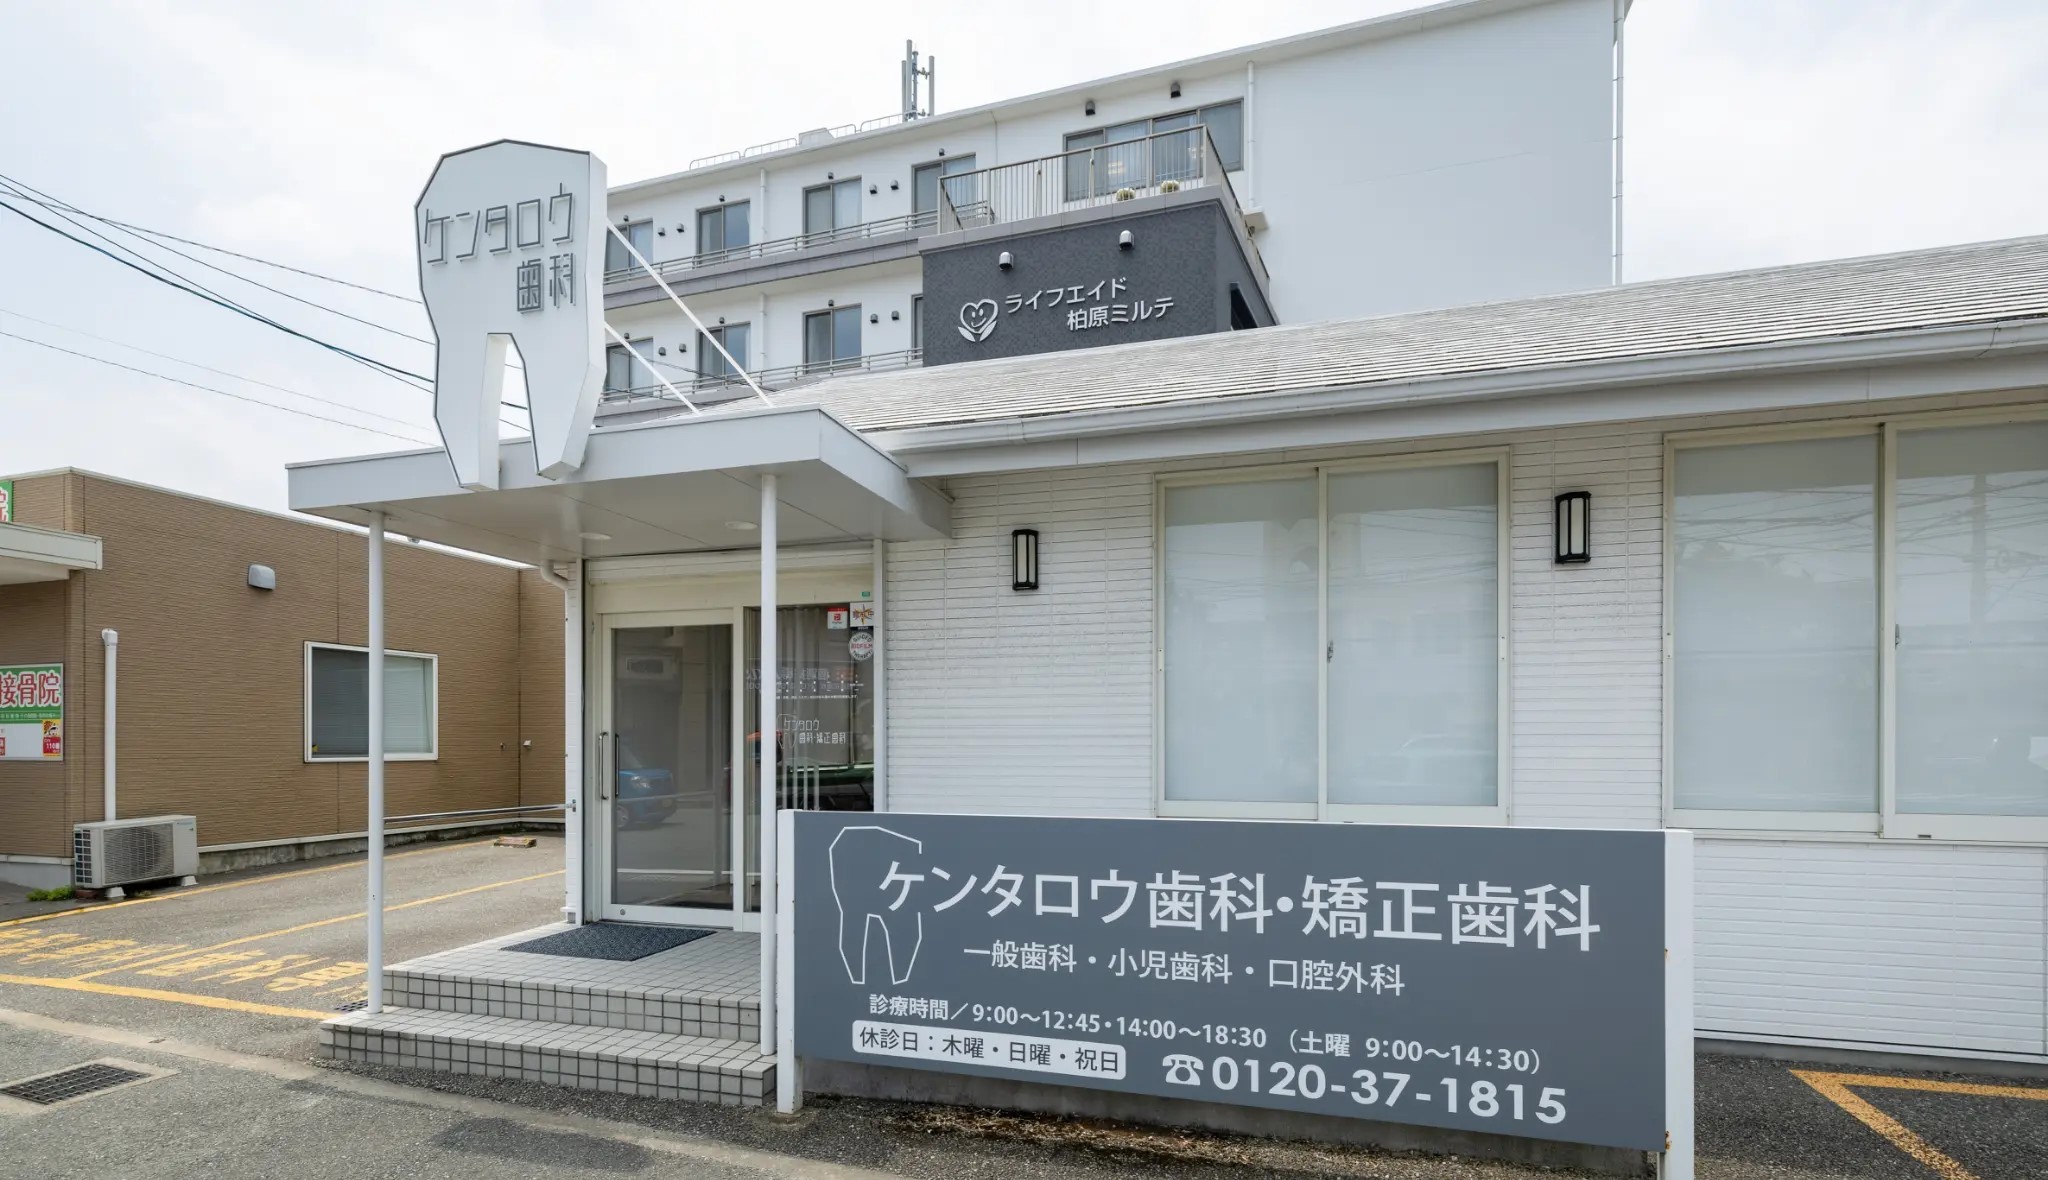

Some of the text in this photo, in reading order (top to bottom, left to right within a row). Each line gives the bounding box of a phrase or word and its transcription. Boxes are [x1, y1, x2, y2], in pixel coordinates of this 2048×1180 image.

[424, 183, 572, 264] ケンタロウ
[517, 252, 573, 312] 歯科
[1005, 277, 1126, 313] ライフエイド
[1067, 297, 1174, 331] 柏原ミルテ
[784, 717, 820, 731] ケンタロウ
[879, 860, 1600, 952] ケンタロウ歯科・矯正歯科
[963, 939, 1406, 996] 一般歯科・小児歯科・口腔外科
[1212, 1056, 1566, 1124] 0120-37-1815
